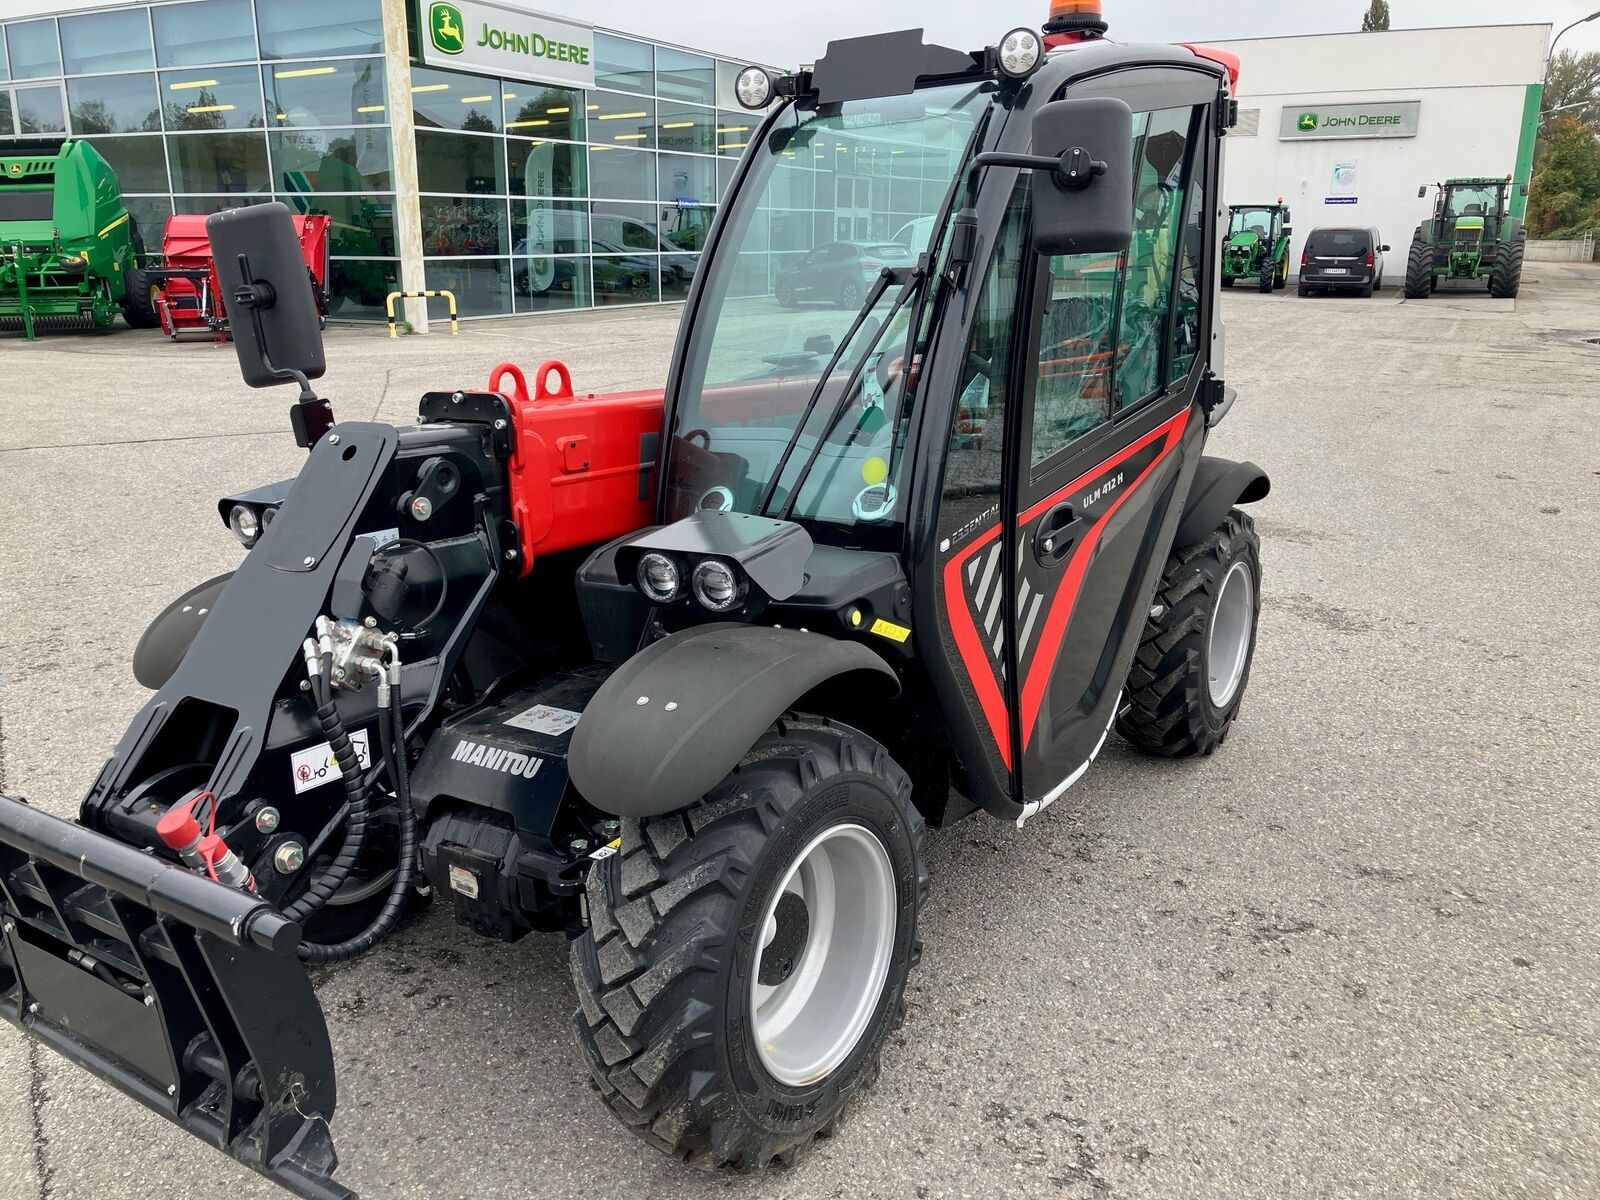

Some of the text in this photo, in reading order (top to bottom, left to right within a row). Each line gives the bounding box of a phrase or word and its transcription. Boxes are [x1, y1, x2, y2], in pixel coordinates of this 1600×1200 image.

[477, 23, 590, 65] JOHN DEERE
[1322, 115, 1401, 127] JOHN DEERE
[1083, 472, 1123, 509] ULM 412 H
[952, 503, 1000, 545] ESSENTIAL
[450, 740, 545, 779] MANITOU
